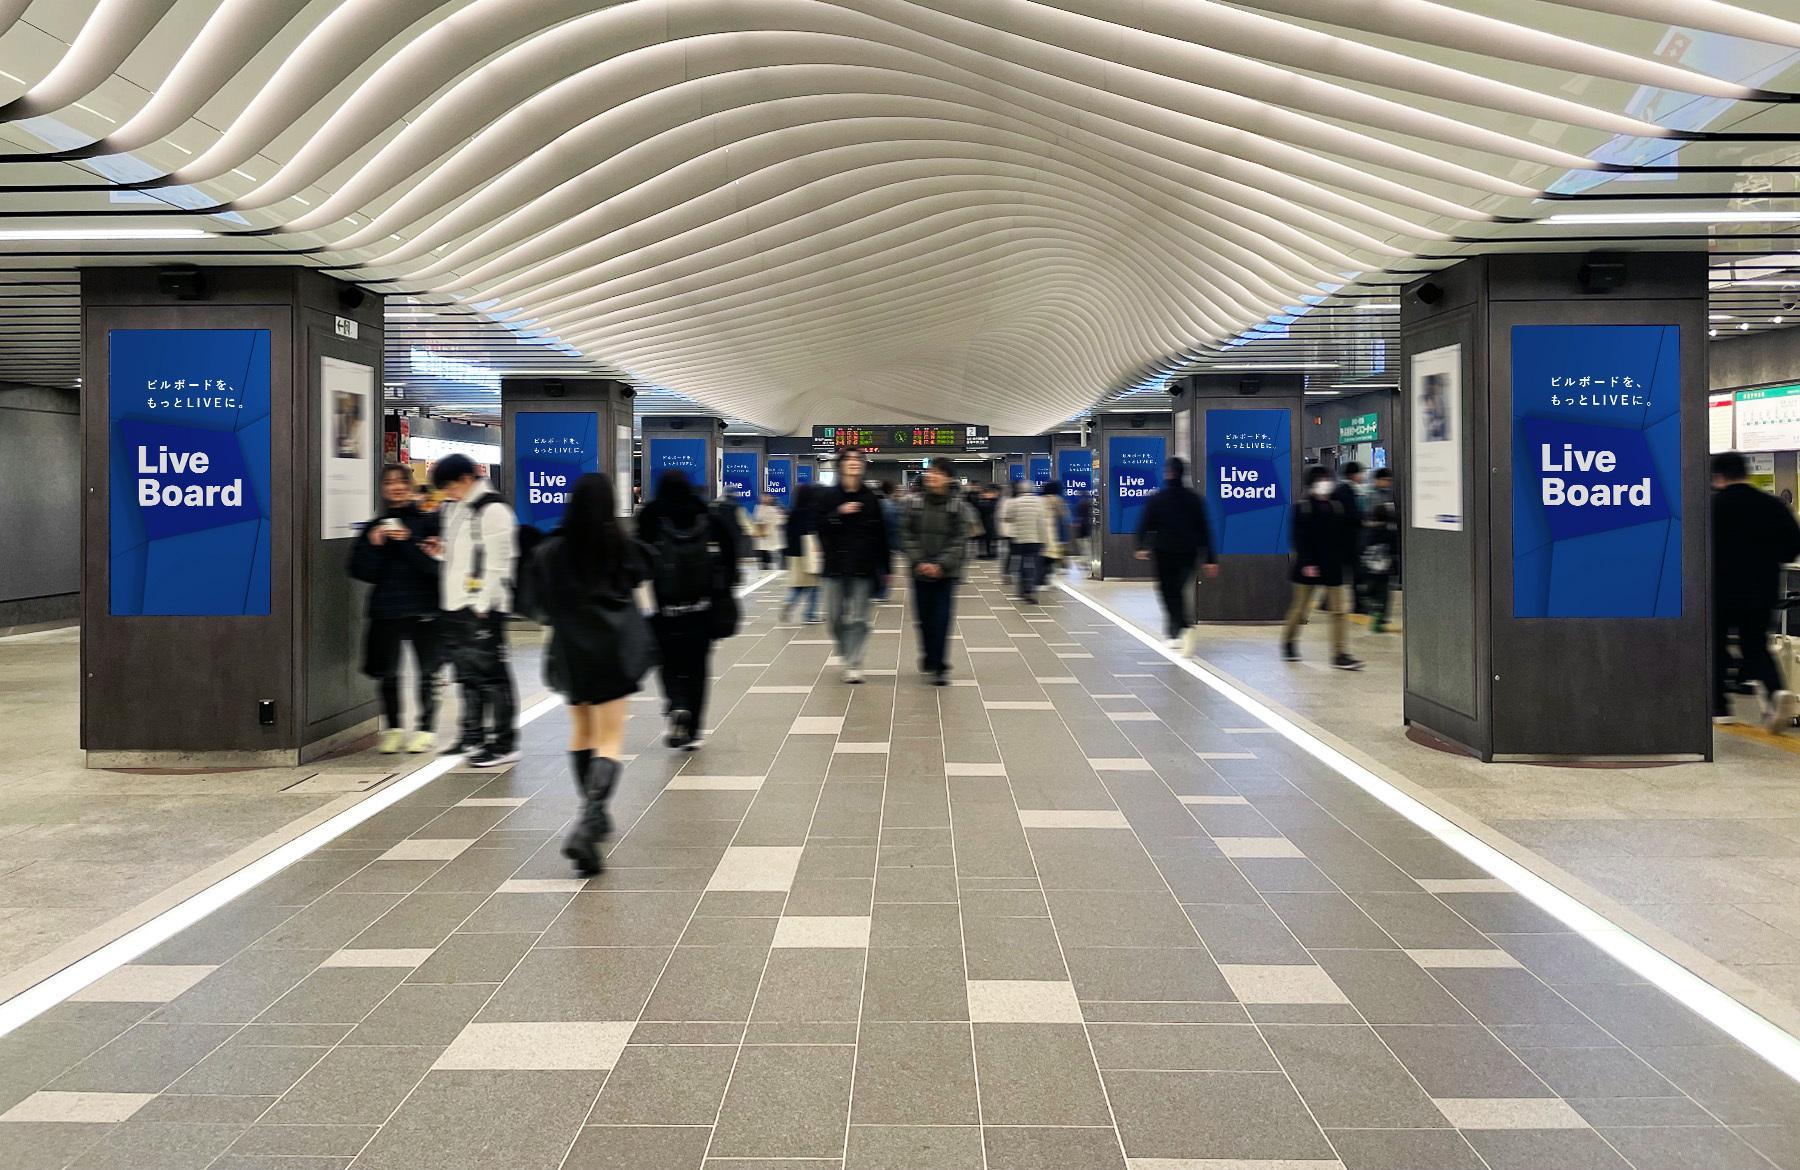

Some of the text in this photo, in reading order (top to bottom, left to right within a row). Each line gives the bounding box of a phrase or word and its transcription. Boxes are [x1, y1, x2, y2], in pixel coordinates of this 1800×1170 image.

[147, 379, 234, 391] ビルボードを、
[1551, 376, 1644, 388] ビルボードを、
[147, 397, 243, 409] もっとLIVEに。
[1551, 394, 1652, 407] もっとLIVEに。
[138, 445, 210, 474] Live
[1541, 443, 1617, 473] Live
[529, 471, 567, 487] Live
[1119, 476, 1145, 486] Live
[1220, 466, 1259, 482] Live
[1066, 480, 1087, 488] Live
[1220, 484, 1276, 499] Board
[138, 478, 243, 507] Board
[529, 488, 573, 504] Boar
[1541, 477, 1651, 507] Board
